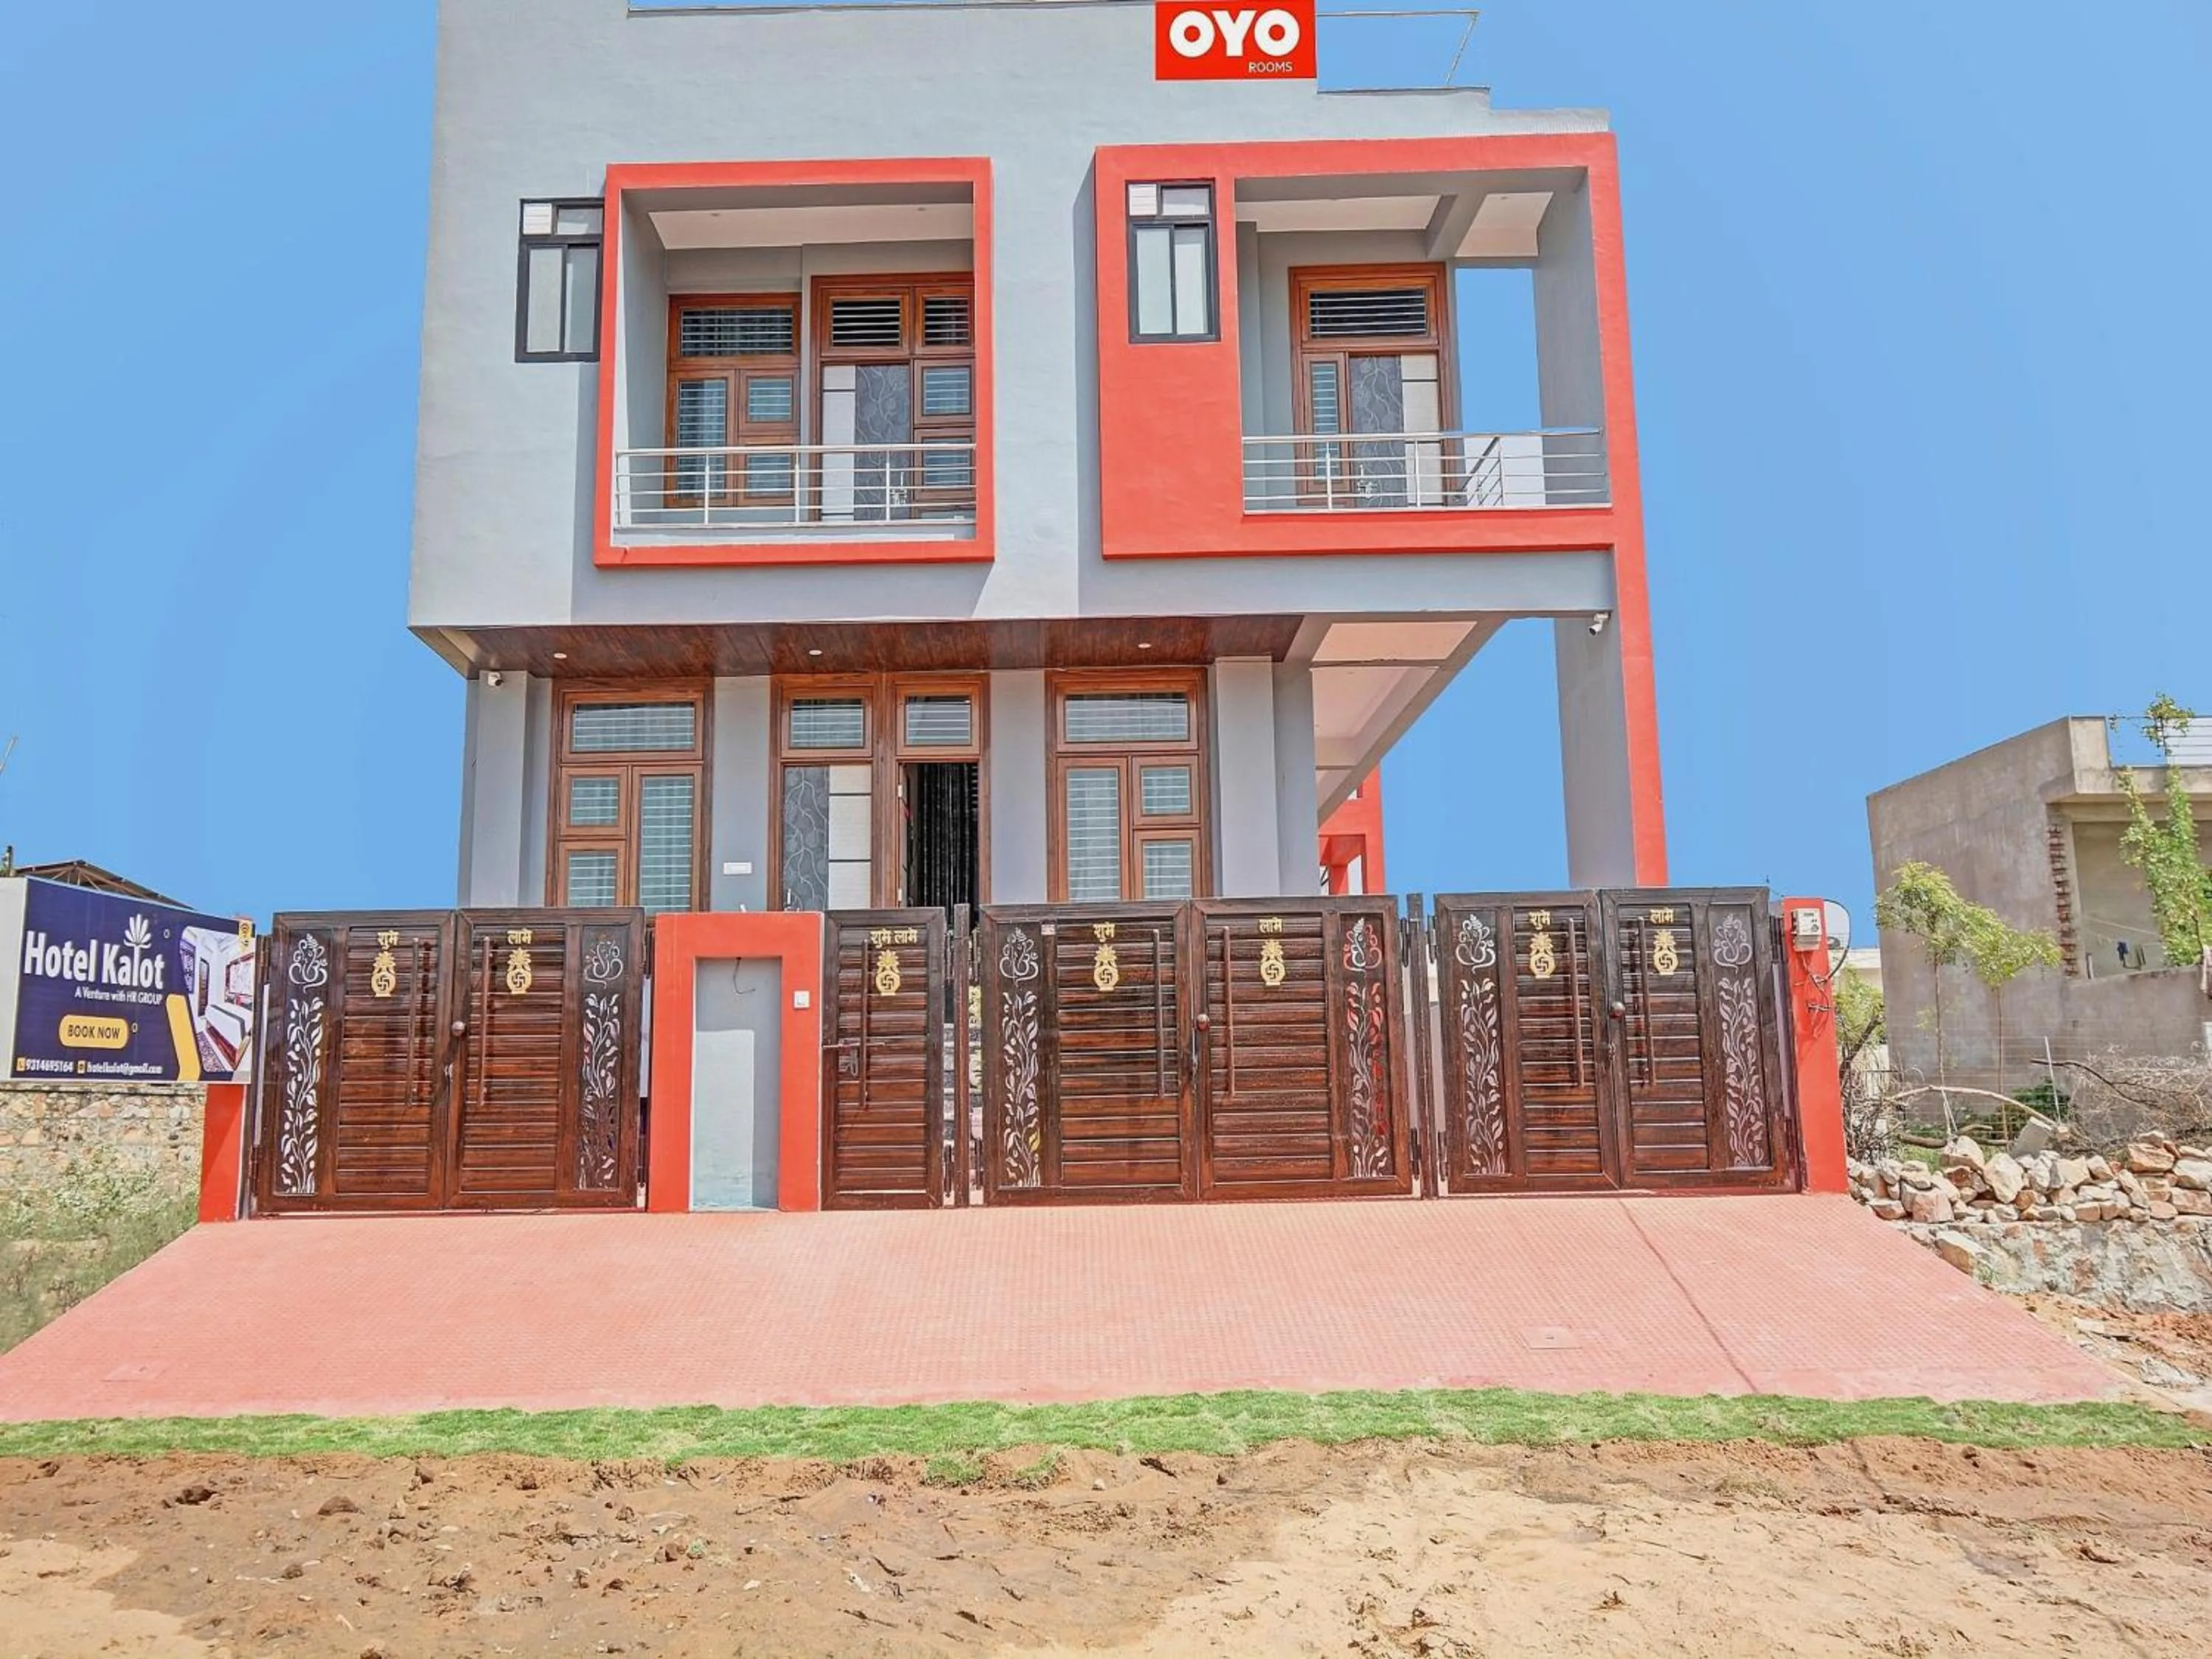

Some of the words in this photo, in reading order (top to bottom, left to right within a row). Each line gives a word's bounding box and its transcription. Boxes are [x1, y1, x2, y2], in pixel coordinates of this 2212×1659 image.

[1169, 8, 1301, 58] OYO
[1248, 61, 1293, 73] ROOMS
[24, 931, 97, 983] Hotel
[102, 942, 165, 990] Kalot
[74, 986, 82, 998] A
[83, 986, 110, 1001] Venture
[111, 990, 125, 1001] with
[138, 992, 163, 1005] GROUP
[67, 1025, 95, 1038] BOOK
[97, 1026, 121, 1039] NOW
